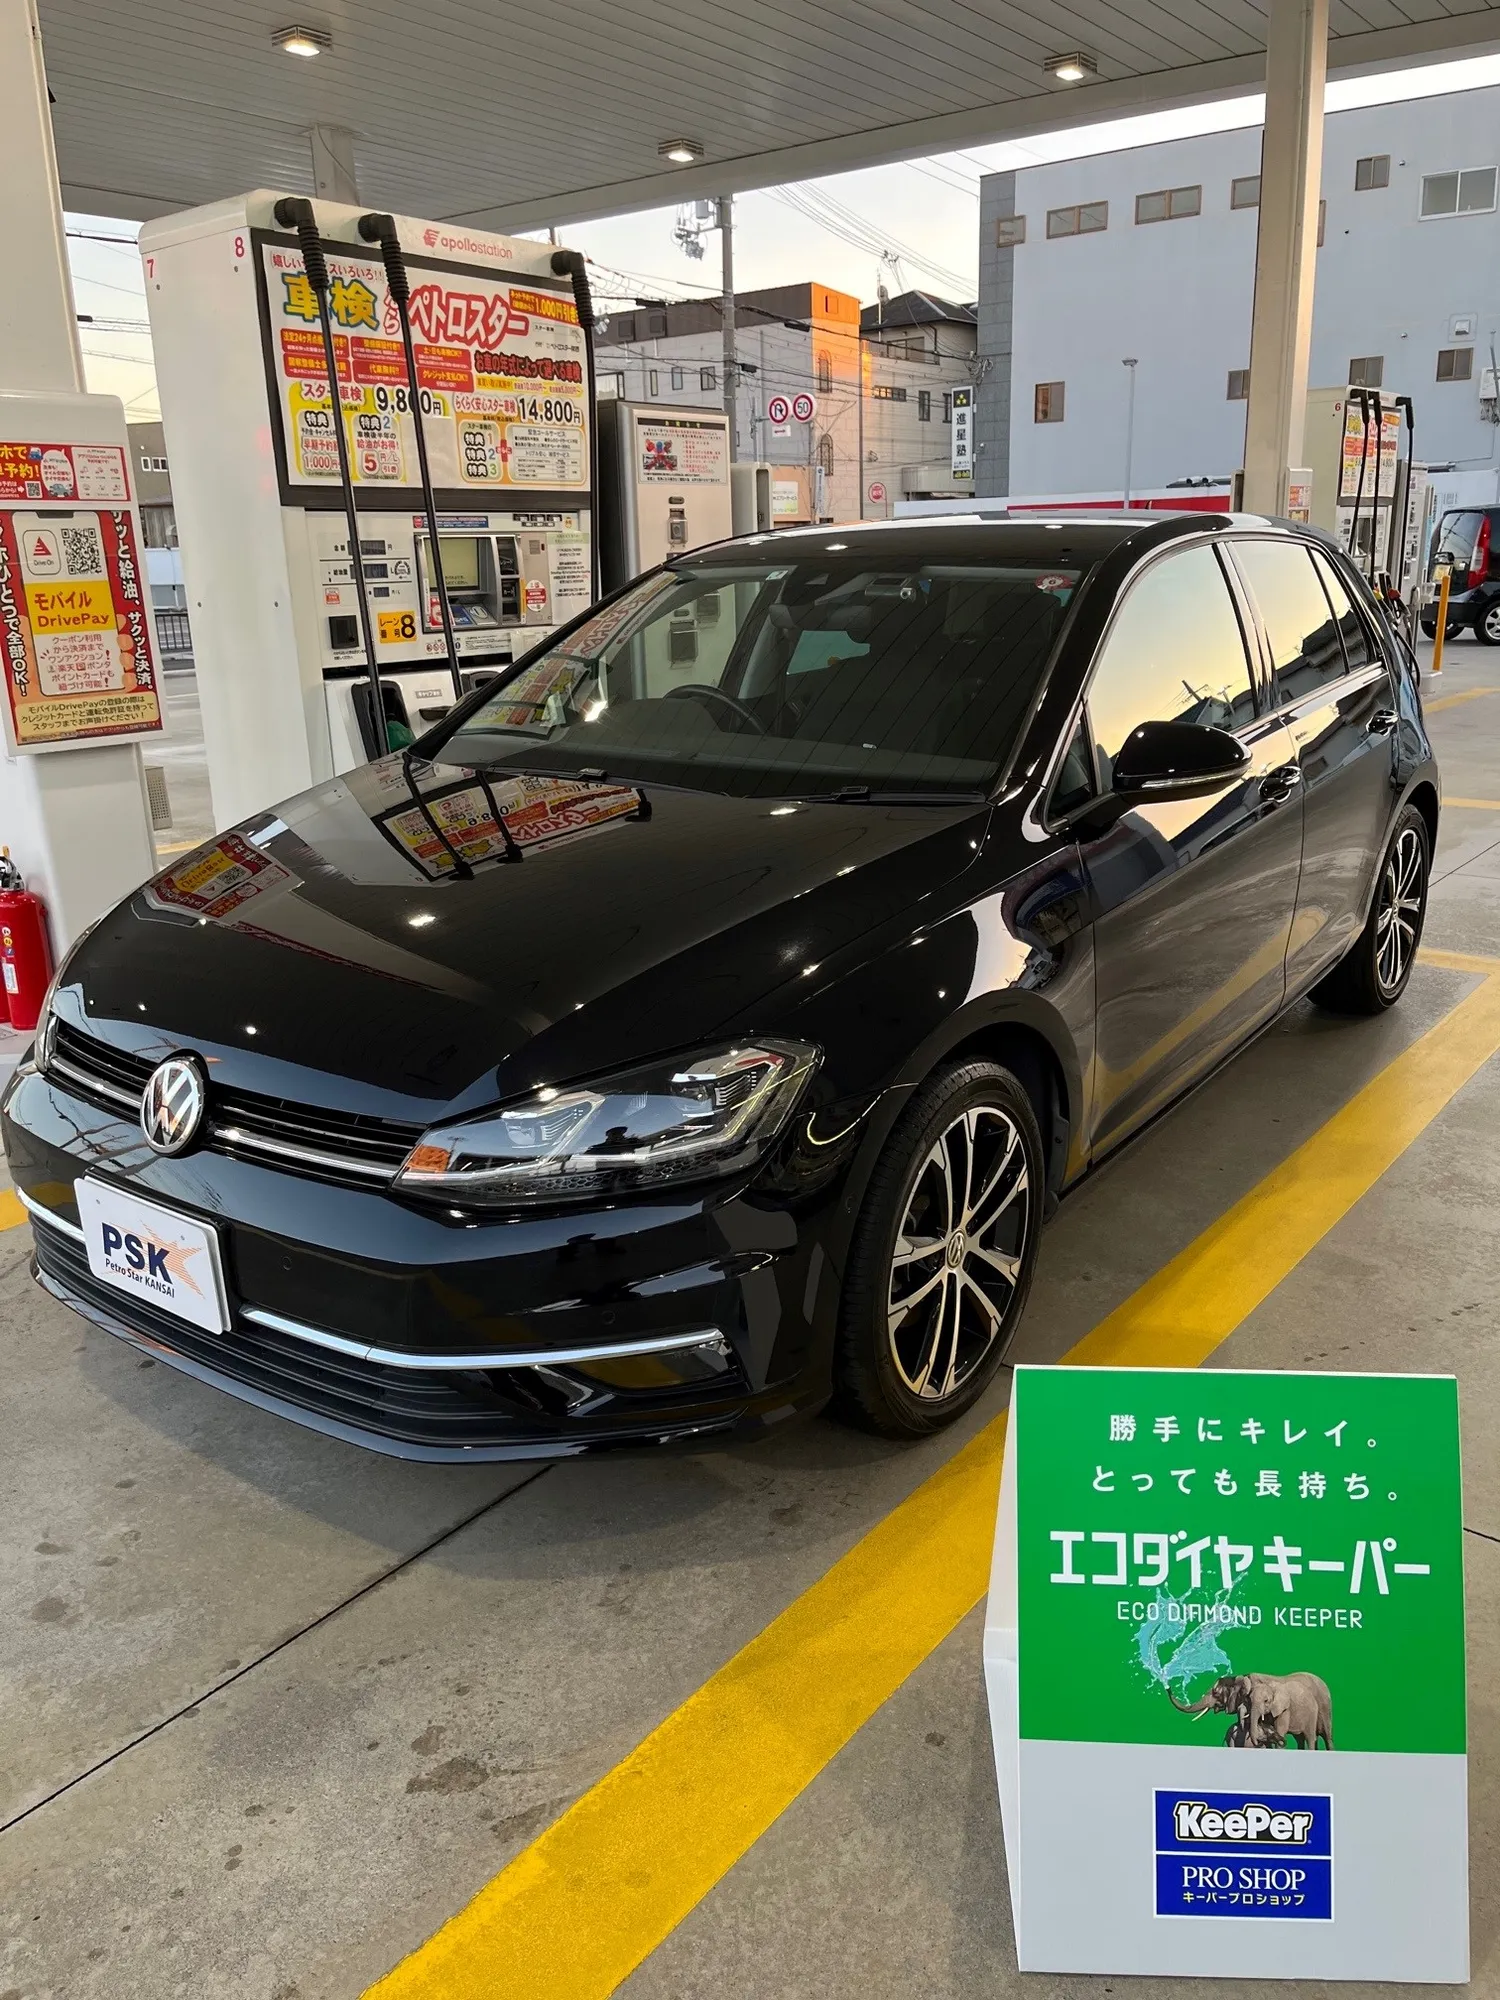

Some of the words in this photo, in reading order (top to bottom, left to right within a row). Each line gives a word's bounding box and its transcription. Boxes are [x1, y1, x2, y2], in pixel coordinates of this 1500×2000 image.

[235, 237, 244, 257] 8
[441, 238, 513, 259] apollostation
[147, 258, 154, 278] 7
[281, 271, 379, 331] 車検
[408, 285, 530, 351] ペトロスター
[519, 398, 581, 424] 14,800円
[797, 401, 808, 414] 50
[1335, 402, 1342, 412] 6
[305, 411, 329, 428] 特典
[359, 414, 381, 432] 特典
[383, 415, 391, 429] 2
[485, 433, 491, 445] 1
[956, 412, 967, 457] 進星塾
[363, 453, 378, 472] 5
[486, 448, 495, 461] 2
[0, 463, 40, 479] 予約!
[487, 464, 496, 476] 3
[34, 591, 92, 611] モバイル
[38, 612, 110, 628] DrivePay
[380, 617, 400, 627] レーン
[400, 614, 416, 639] 8
[52, 634, 103, 645] クーポン利用
[53, 643, 105, 655] から決済まで
[52, 670, 115, 682] ポイントカードも
[21, 702, 154, 724] クレジットカードと運転免許証を持って
[101, 1222, 174, 1285] PSK
[105, 1257, 126, 1278] Petro
[127, 1267, 143, 1285] Star
[144, 1276, 175, 1299] KANSAI
[1109, 1414, 1379, 1448] 勝手にキレイ。
[1093, 1465, 1398, 1501] とっても長持ち。
[1050, 1530, 1431, 1595] エコダイヤキーパー
[1117, 1601, 1159, 1622] ECO
[1168, 1602, 1262, 1626] DIAMOND
[1275, 1606, 1364, 1629] KEEPER
[1174, 1801, 1313, 1845] KeePer
[1182, 1866, 1234, 1888] PRO
[1238, 1867, 1306, 1890] SHOP
[1183, 1891, 1305, 1906] キーパープロショップ
